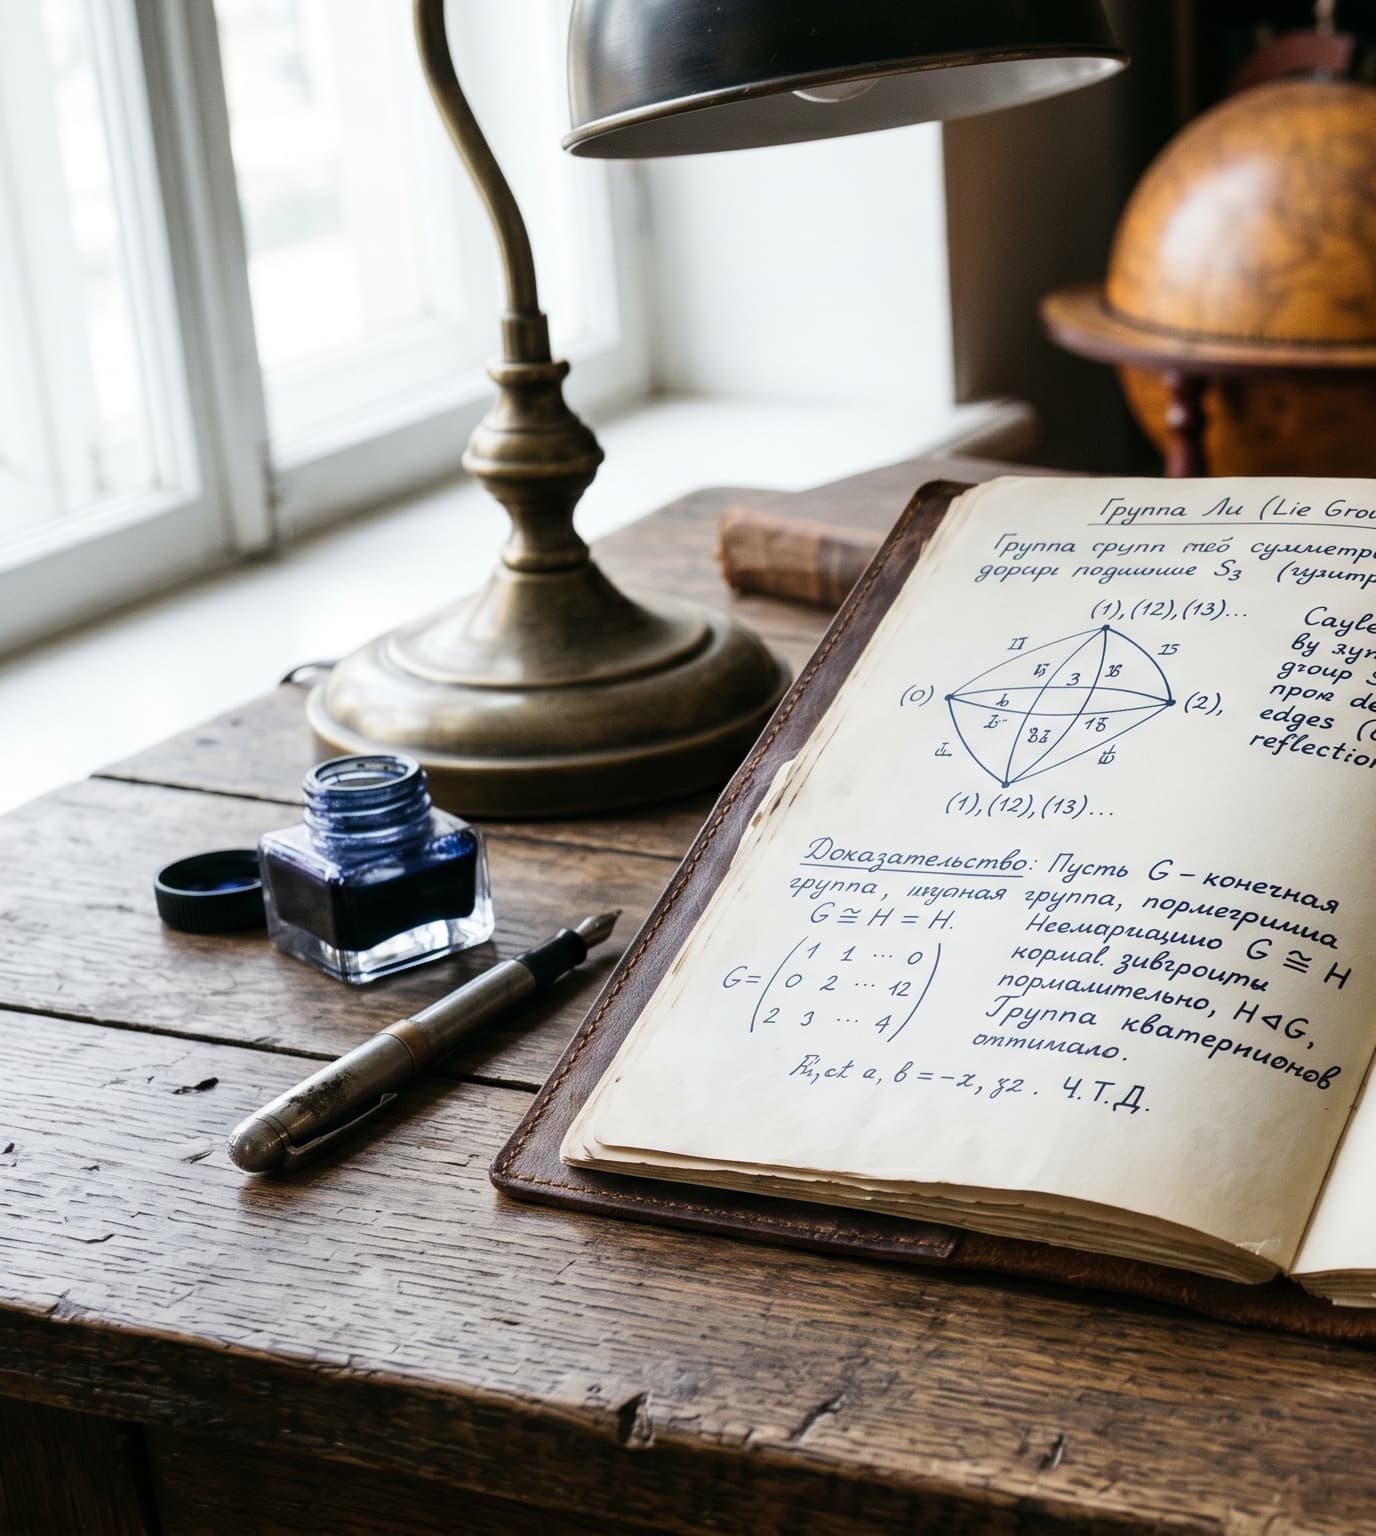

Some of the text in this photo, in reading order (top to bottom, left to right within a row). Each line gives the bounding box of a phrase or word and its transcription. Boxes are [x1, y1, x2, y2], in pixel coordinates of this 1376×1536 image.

[1100, 498, 1188, 525] Группа
[1201, 496, 1244, 518] Ли
[1258, 494, 1312, 521] (Lie
[993, 532, 1077, 561] Группа
[1258, 704, 1336, 733] edges
[804, 836, 1340, 919] Доказательство: Пусть G конечная
[789, 877, 889, 902] группа,
[1024, 889, 1123, 913] группа,
